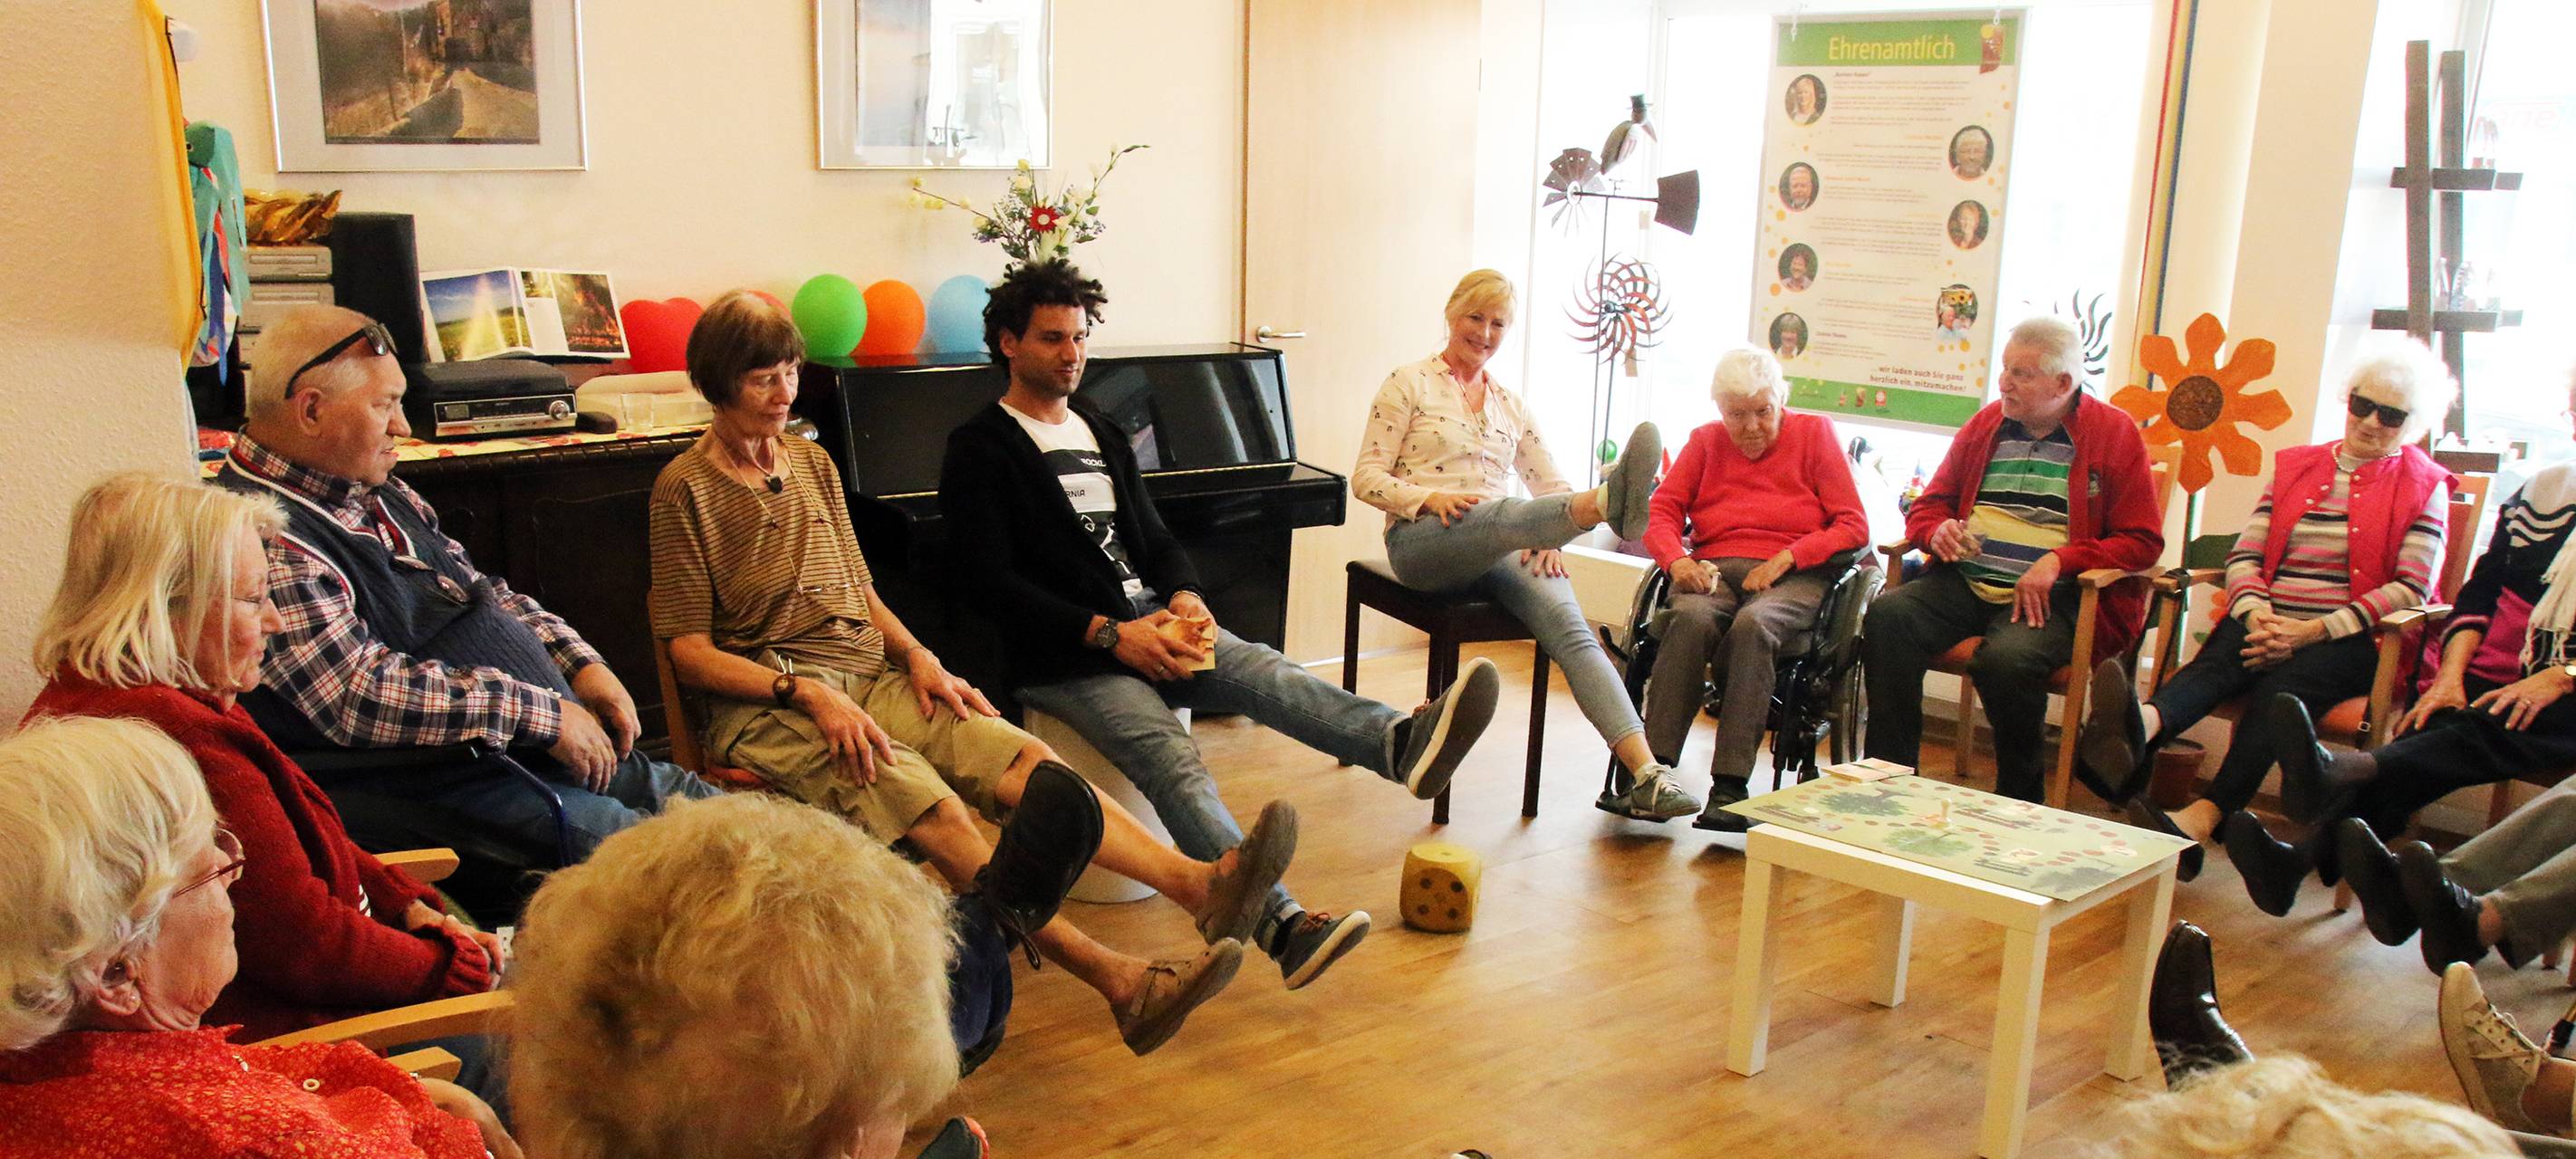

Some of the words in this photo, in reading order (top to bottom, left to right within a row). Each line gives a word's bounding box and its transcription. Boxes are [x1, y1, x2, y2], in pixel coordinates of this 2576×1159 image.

[1829, 34, 1956, 60] Ehrenamtlich
[1870, 374, 1898, 384] herzlich
[1892, 367, 1912, 376] laden
[1914, 369, 1931, 378] auch
[1946, 373, 1964, 381] ganz
